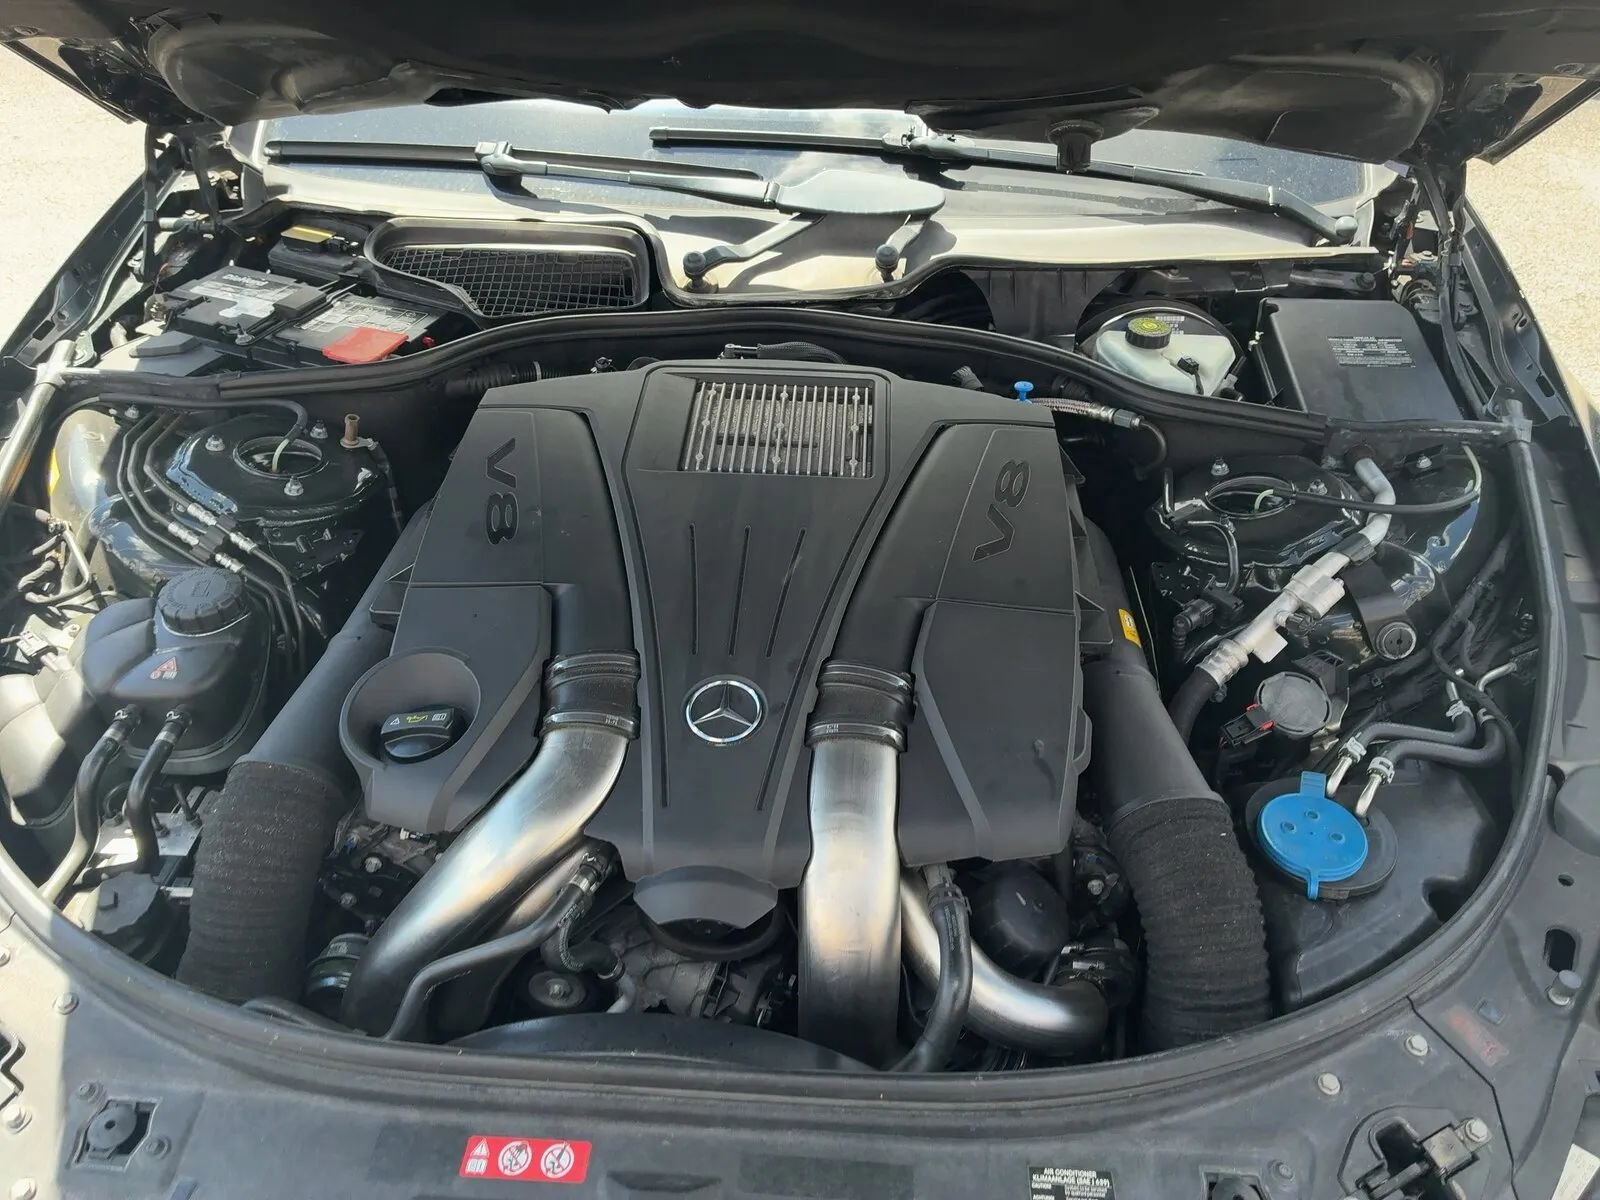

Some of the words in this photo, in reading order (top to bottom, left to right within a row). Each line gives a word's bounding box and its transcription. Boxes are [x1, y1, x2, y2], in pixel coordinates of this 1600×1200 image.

[486, 437, 519, 546] V8
[971, 459, 1032, 563] V8
[1043, 1167, 1054, 1175] AIR
[1055, 1168, 1097, 1178] CONDITIONER
